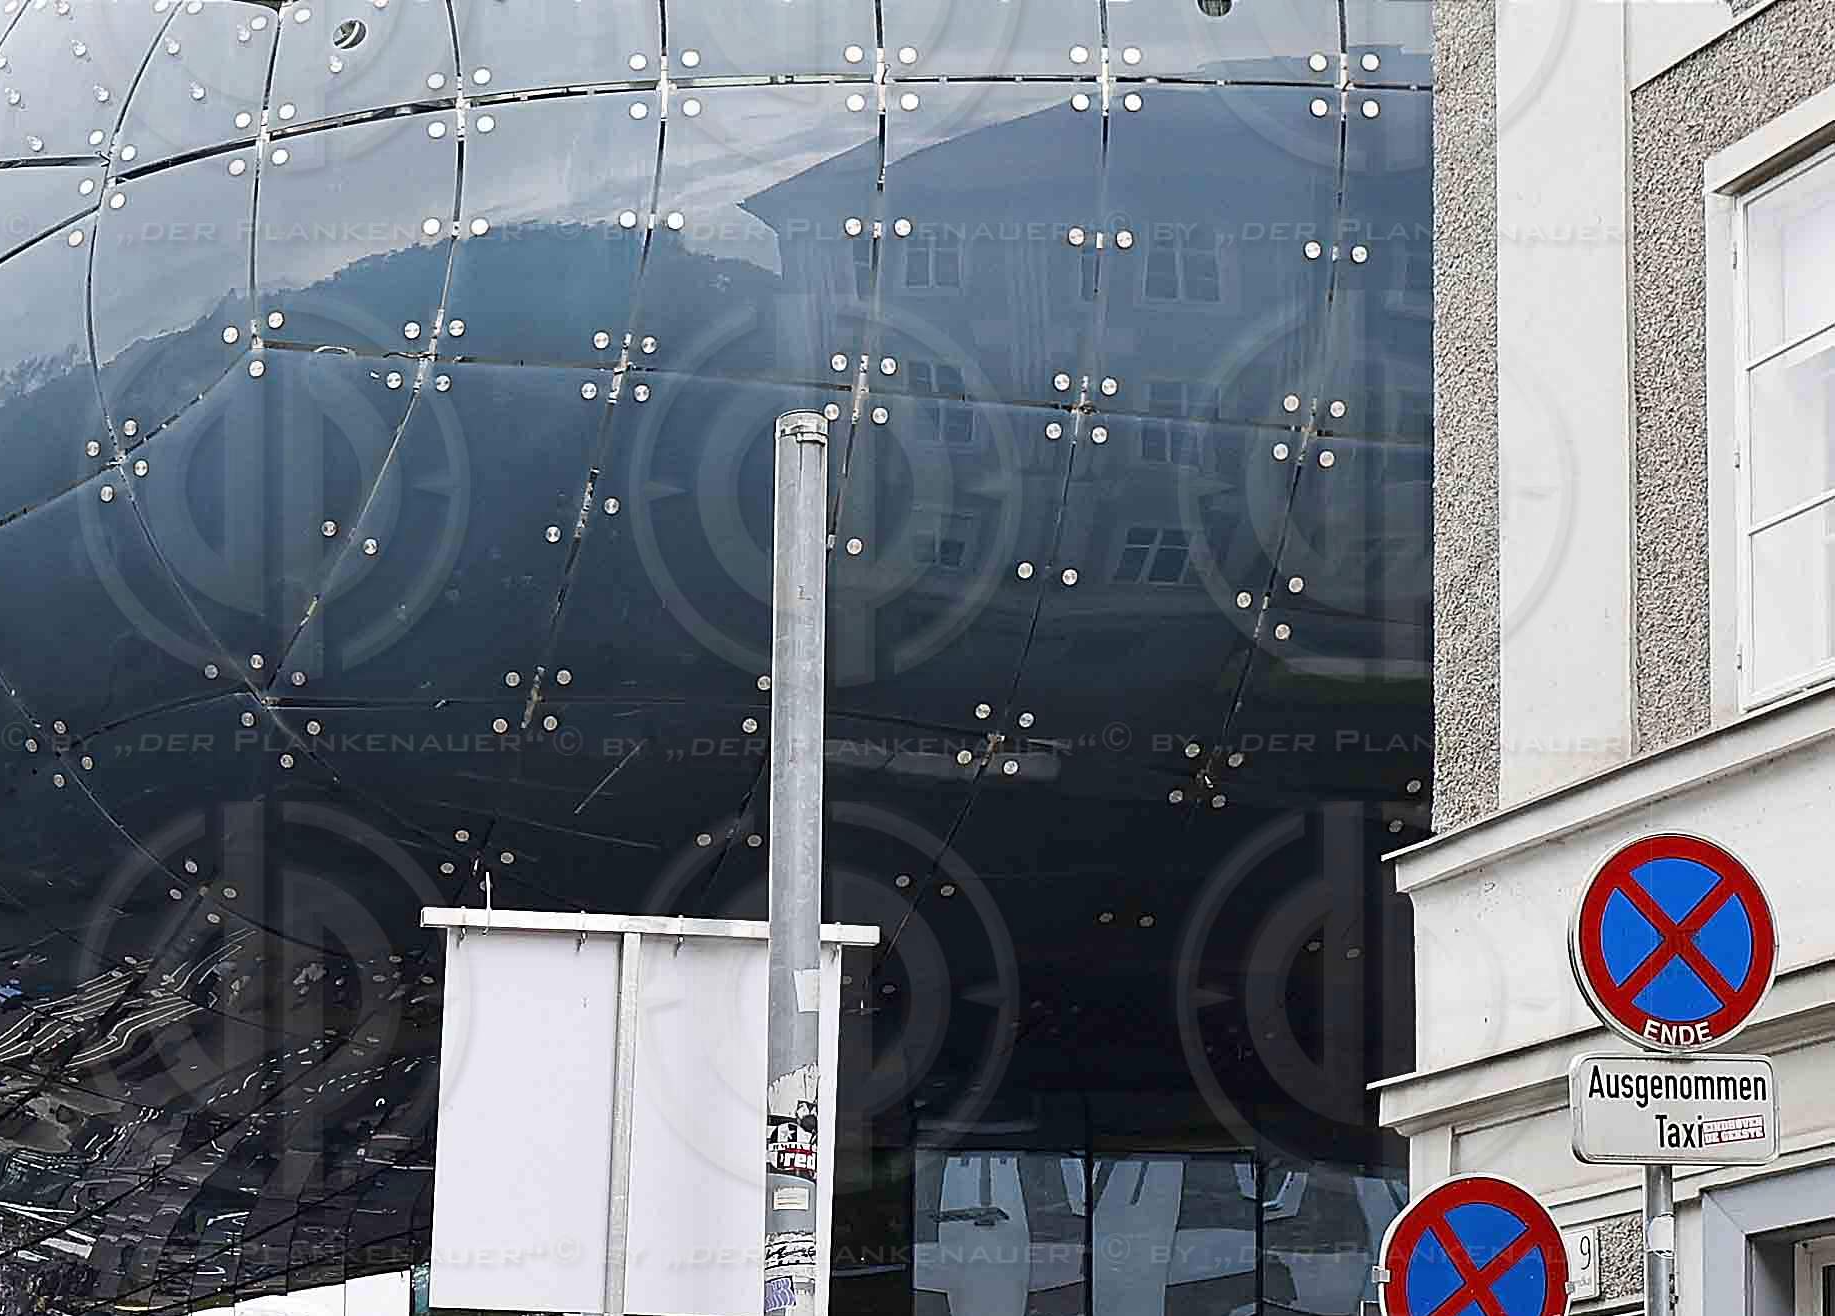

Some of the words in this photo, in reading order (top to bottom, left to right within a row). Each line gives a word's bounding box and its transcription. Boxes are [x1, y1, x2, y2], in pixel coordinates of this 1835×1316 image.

[1644, 1019, 1712, 1046] ENDE
[1589, 1065, 1766, 1108] Ausgenommen
[1655, 1114, 1703, 1148] Taxi
[1580, 1236, 1591, 1270] 9
